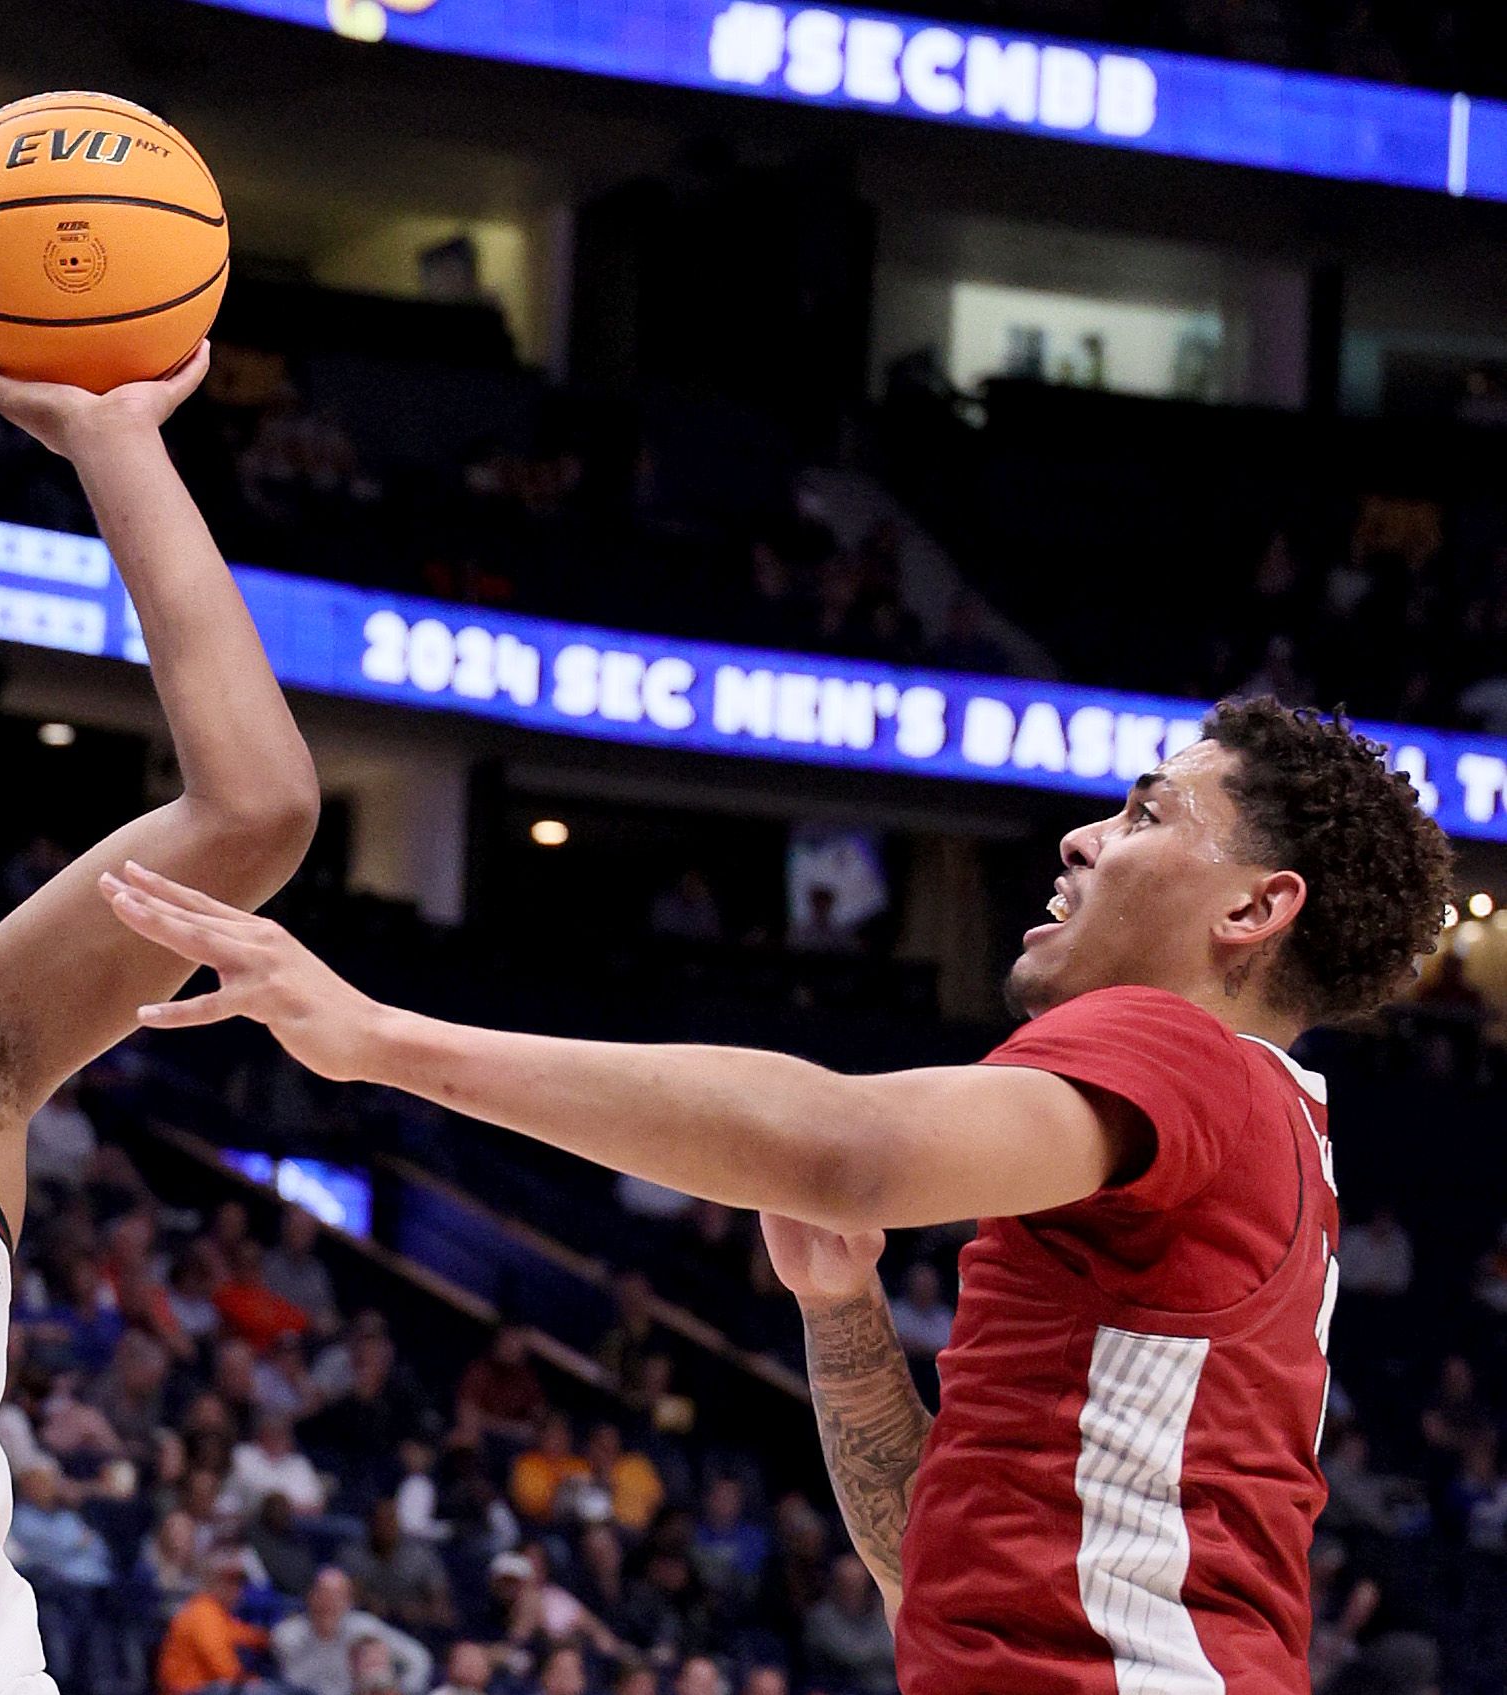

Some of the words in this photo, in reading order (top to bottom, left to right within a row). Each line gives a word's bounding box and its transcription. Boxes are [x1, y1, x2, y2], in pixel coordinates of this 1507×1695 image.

[709, 1, 1157, 138] #SECMBB
[6, 128, 133, 170] EVO
[135, 138, 172, 158] NXT
[362, 610, 541, 707] 2024
[552, 644, 696, 731] SEC
[713, 664, 946, 759] MEN'S
